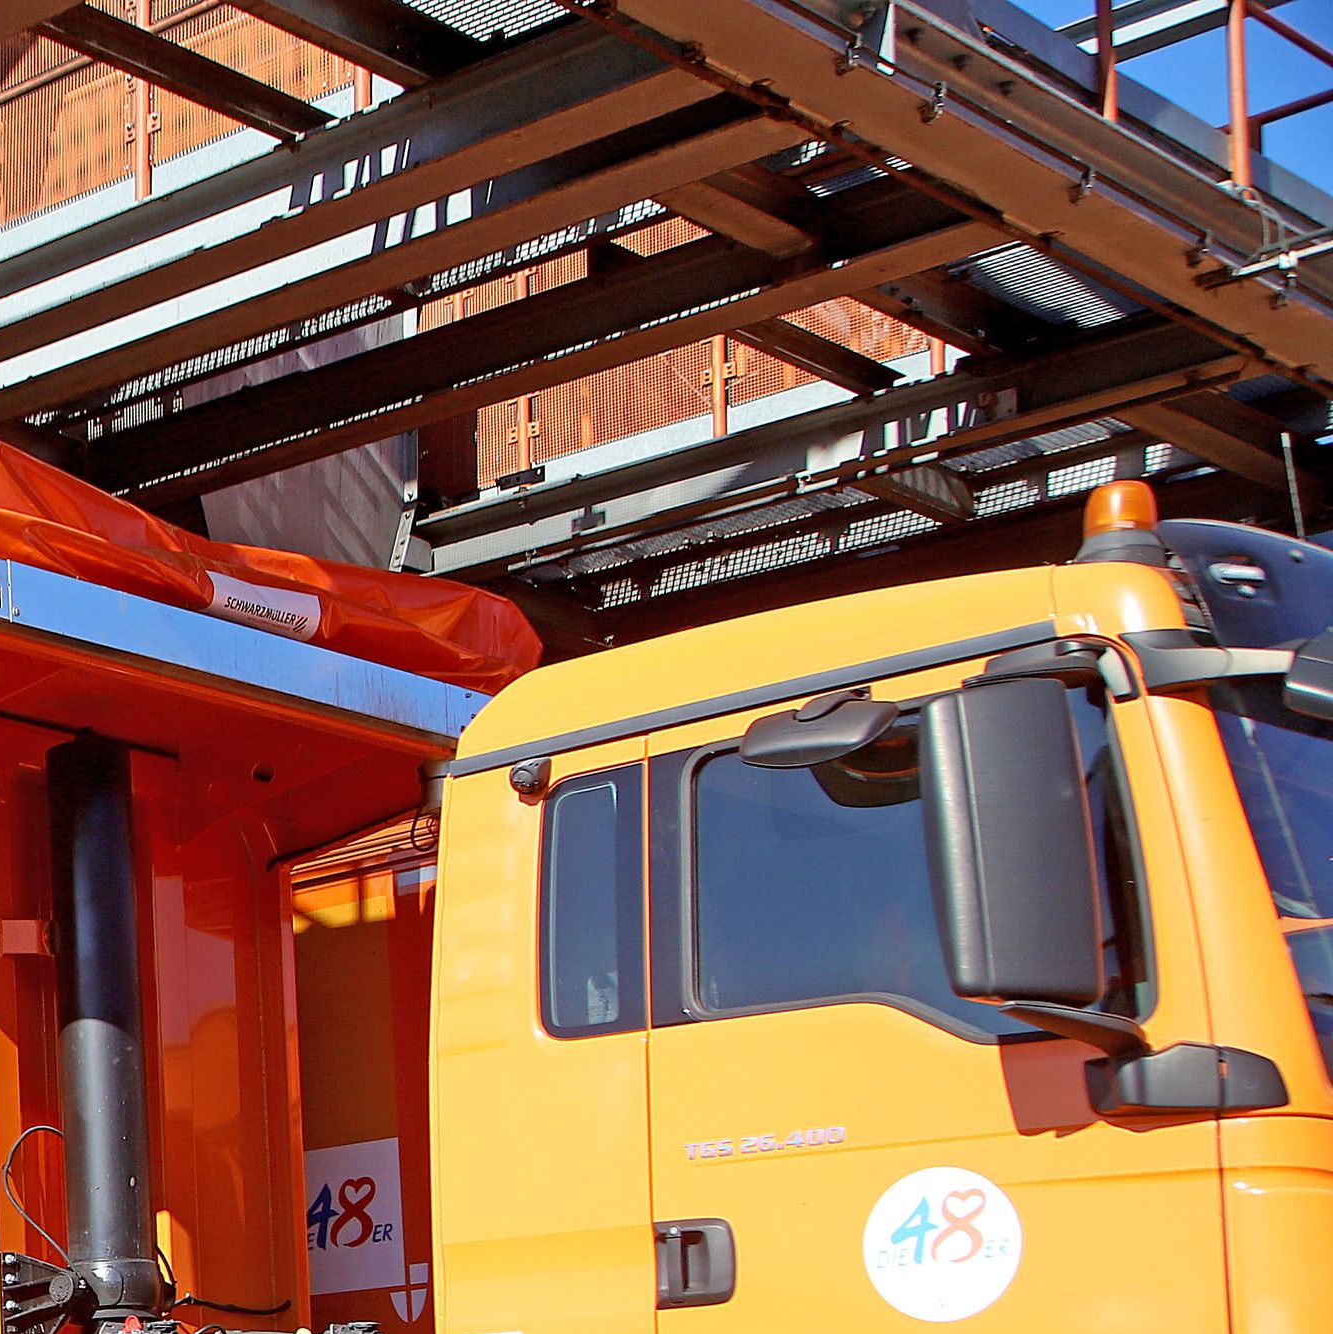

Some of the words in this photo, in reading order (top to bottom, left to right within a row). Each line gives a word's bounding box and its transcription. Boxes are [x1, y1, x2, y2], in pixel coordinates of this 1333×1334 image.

[224, 596, 297, 626] SCHWARZMÜLLER
[683, 1139, 733, 1160] TGS
[741, 1126, 846, 1154] 26.400
